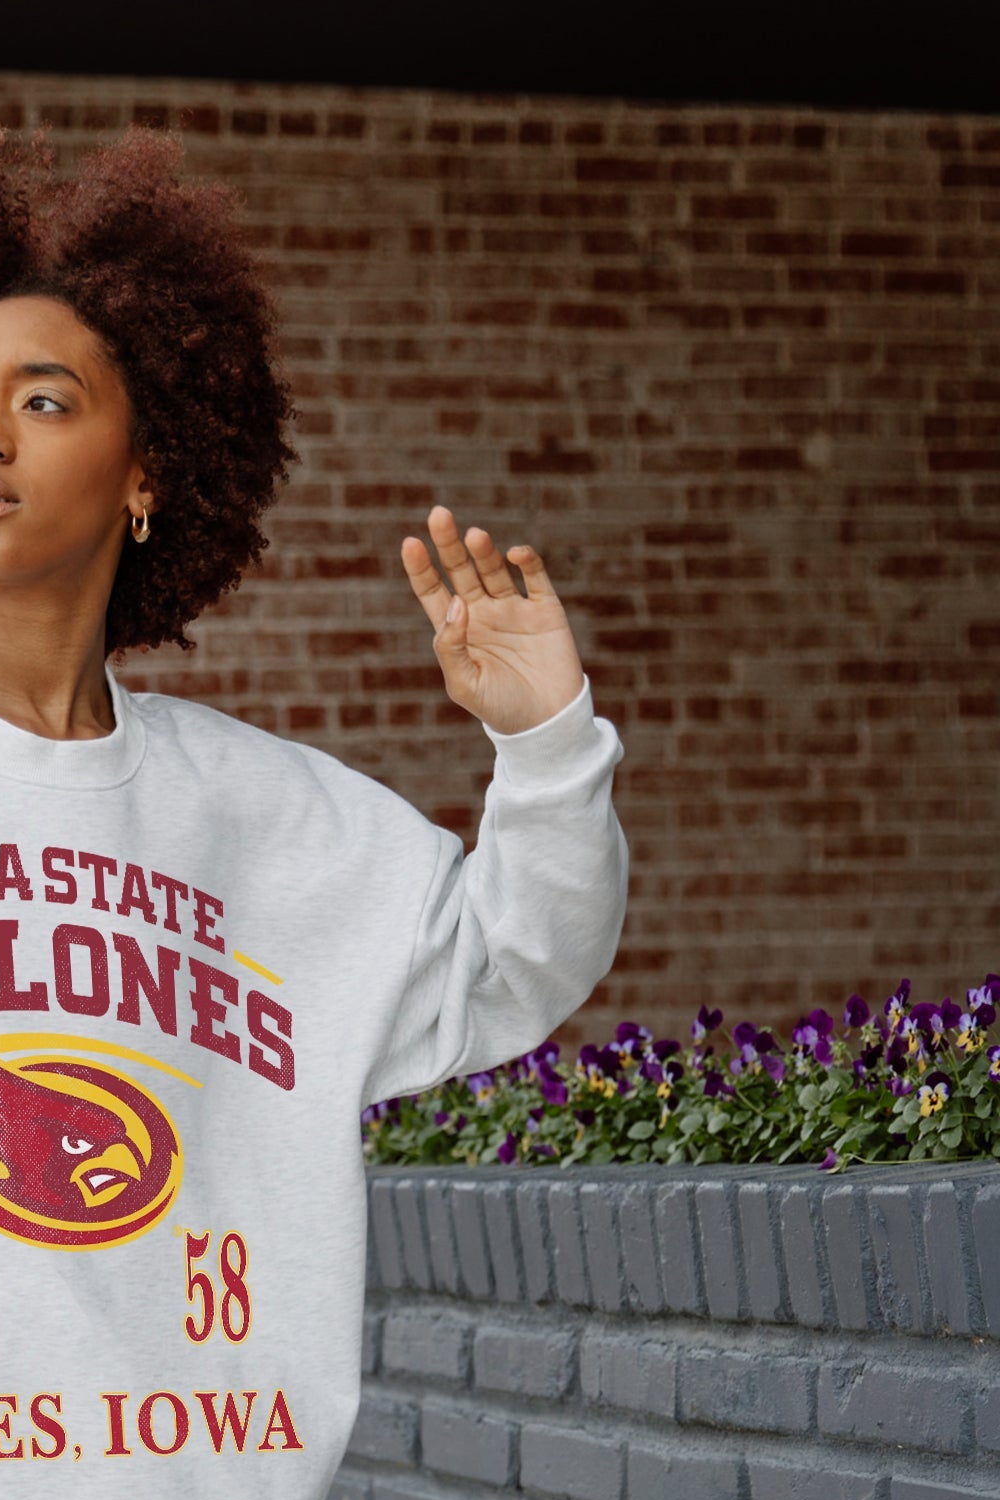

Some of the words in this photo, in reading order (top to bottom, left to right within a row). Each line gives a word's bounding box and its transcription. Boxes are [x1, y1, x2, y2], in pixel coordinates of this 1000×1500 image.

[41, 846, 226, 955] STATE
[183, 1228, 253, 1345] 58
[100, 1387, 305, 1459] IOWA
